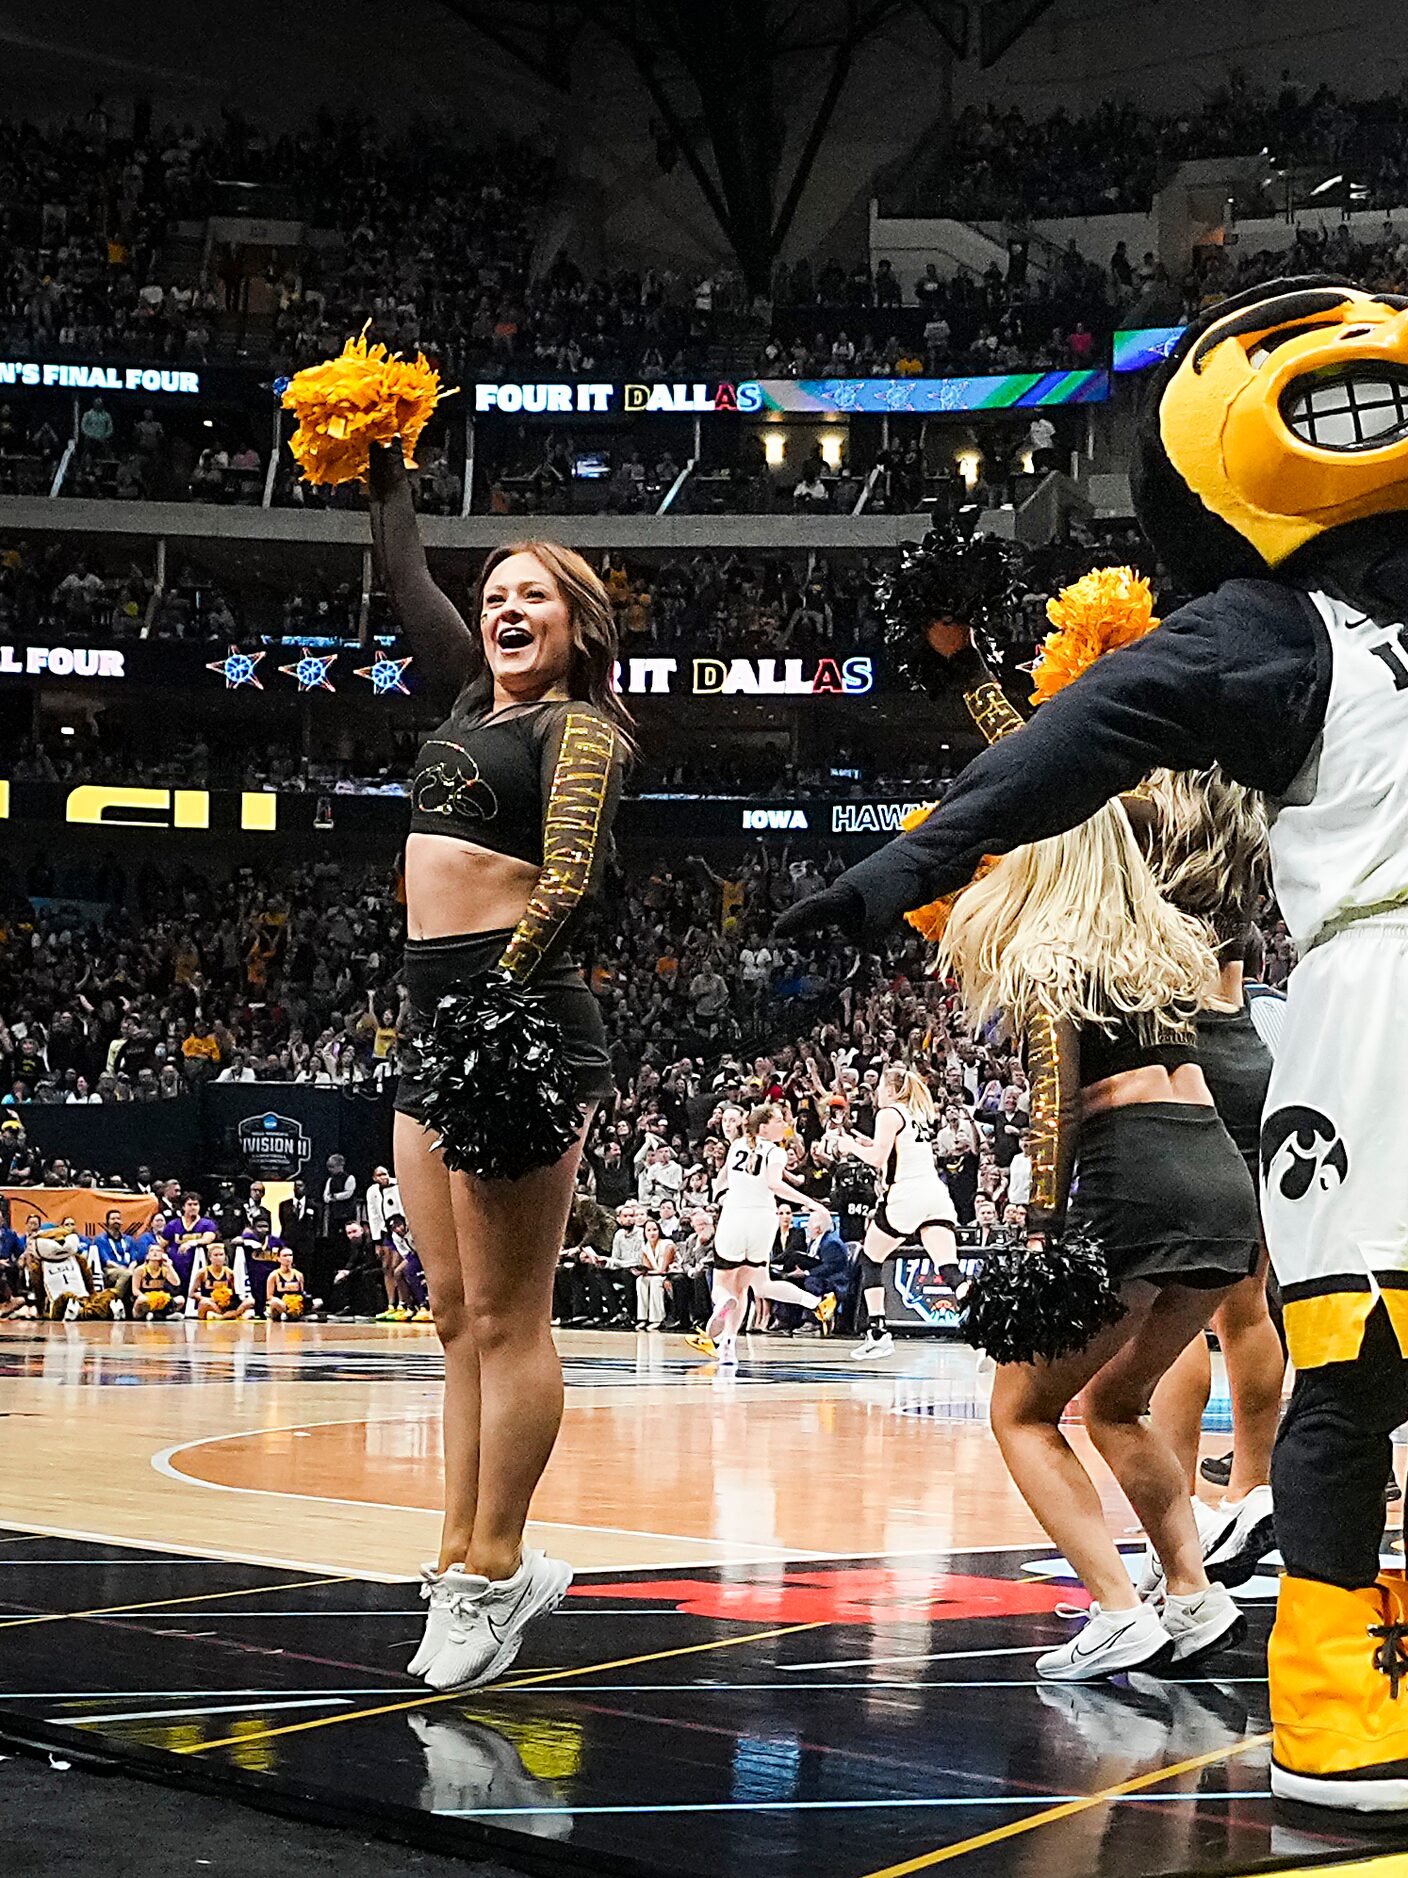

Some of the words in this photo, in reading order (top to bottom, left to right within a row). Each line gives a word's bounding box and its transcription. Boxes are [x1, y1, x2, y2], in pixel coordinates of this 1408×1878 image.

[43, 364, 122, 389] FINAL
[126, 369, 199, 393] FOUR
[475, 384, 572, 412] FOUR
[577, 384, 613, 411] IT
[624, 383, 762, 412] DALLAS
[26, 647, 125, 677] FOUR
[629, 658, 677, 693] IT
[693, 657, 873, 694] DALLAS
[742, 810, 808, 829] IOWA
[243, 1137, 294, 1155] IVISION
[848, 1203, 869, 1216] 842
